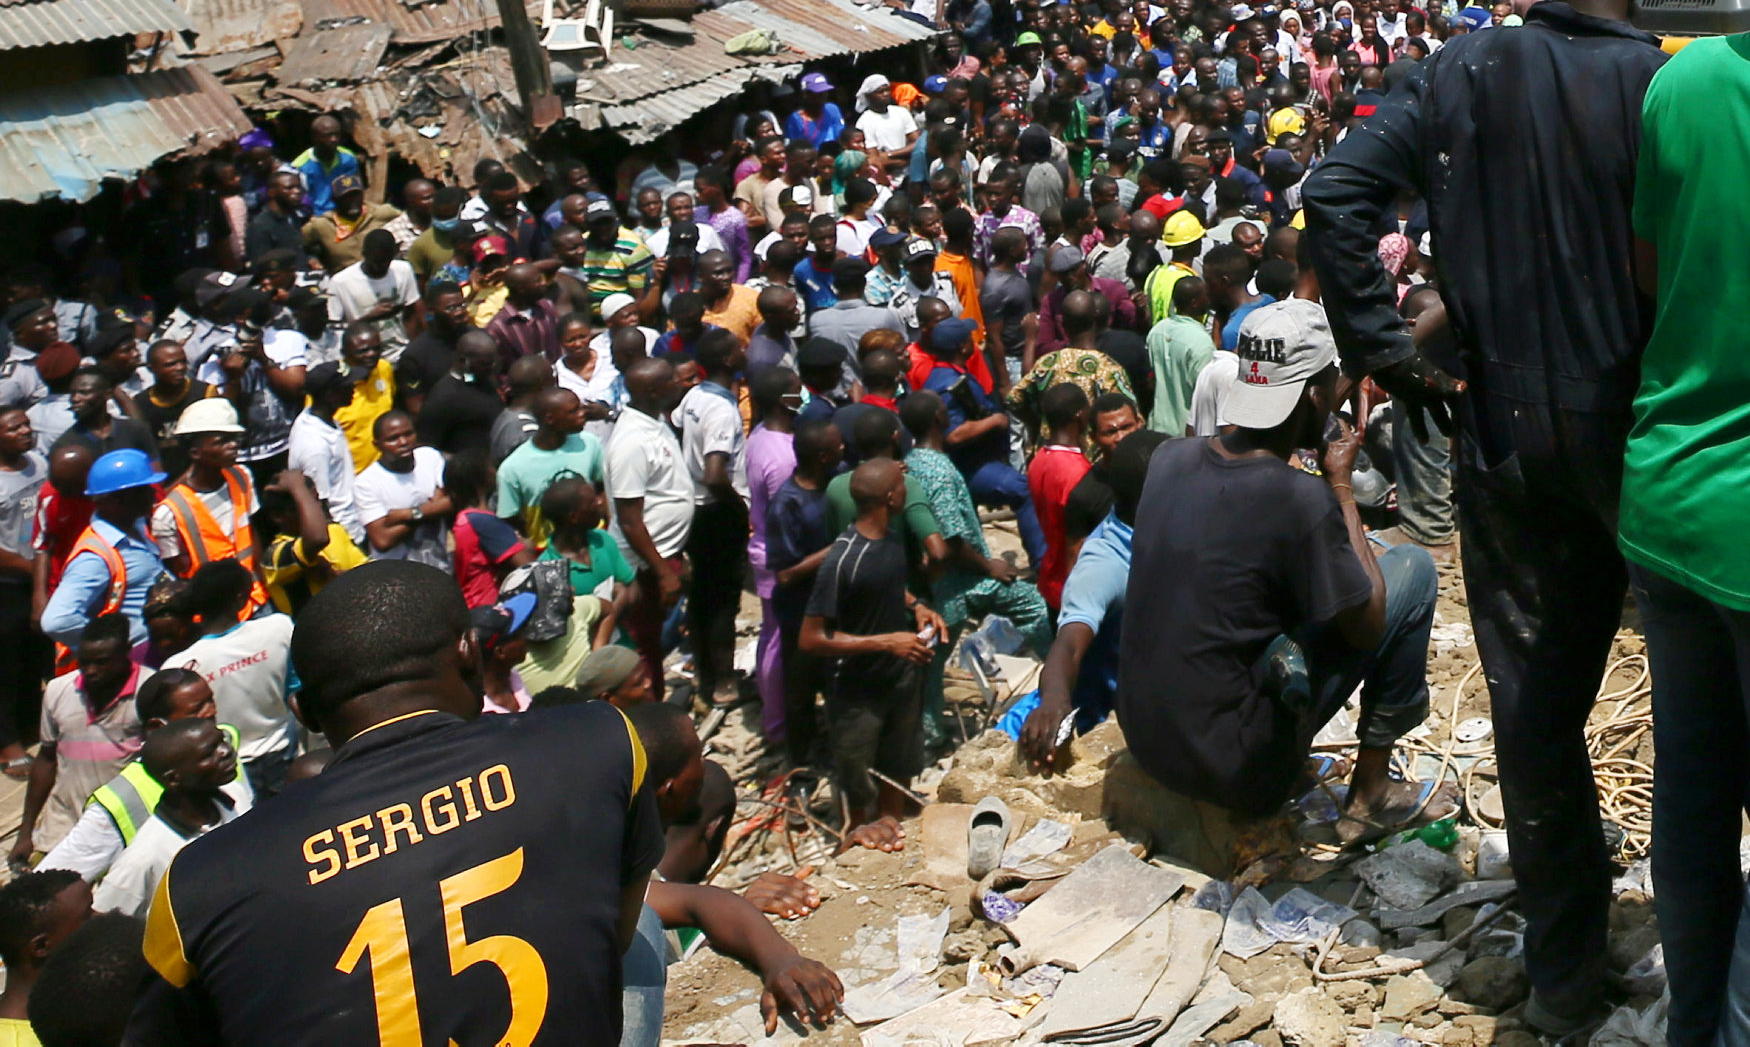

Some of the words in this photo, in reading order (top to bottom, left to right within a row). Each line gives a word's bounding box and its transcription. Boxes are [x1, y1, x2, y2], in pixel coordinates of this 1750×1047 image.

[1250, 361, 1259, 377] 4
[219, 649, 269, 677] PRINCE
[302, 763, 517, 886] SERGIO
[334, 845, 549, 1047] 15
